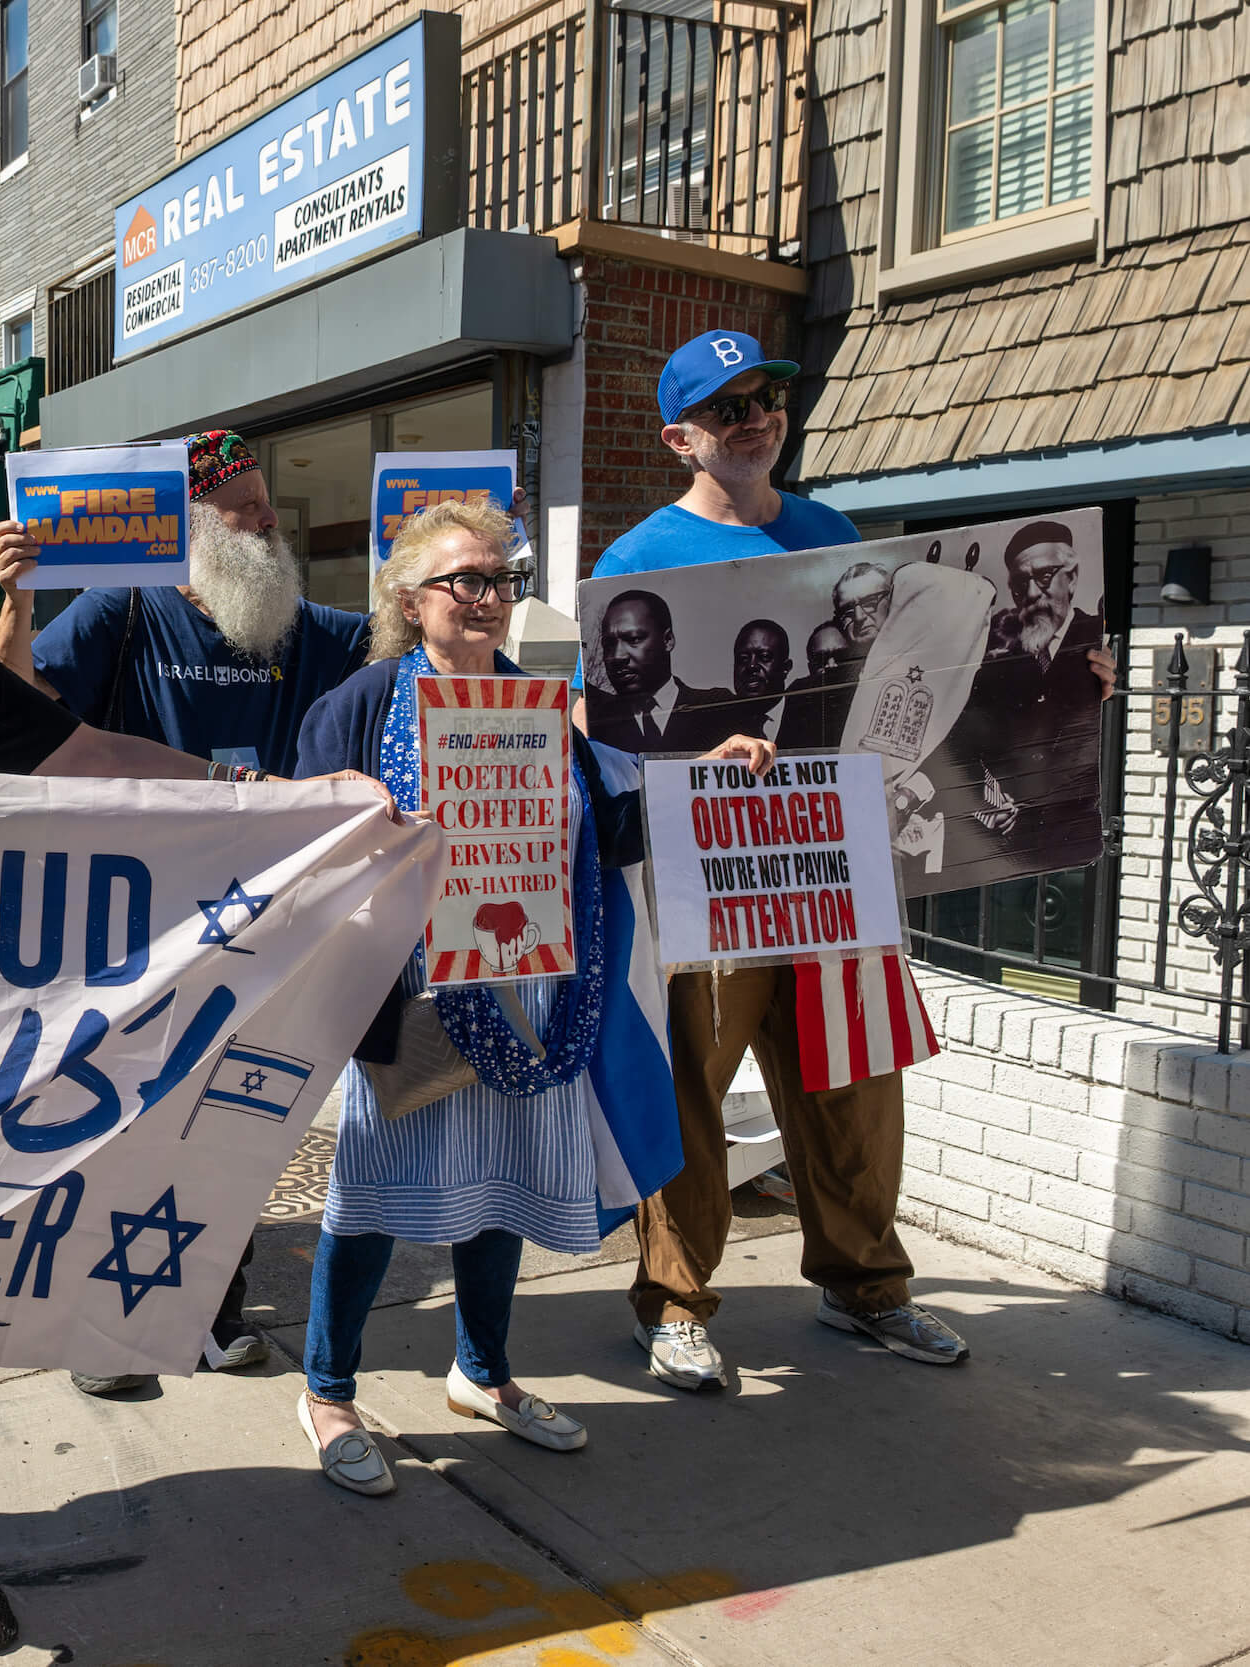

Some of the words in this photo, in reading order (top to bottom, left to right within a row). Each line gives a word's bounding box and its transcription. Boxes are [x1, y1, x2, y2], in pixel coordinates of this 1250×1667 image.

[163, 166, 245, 247] REAL
[259, 58, 410, 196] ESTATE
[294, 166, 384, 229] CONSULTANTS
[276, 214, 346, 265] APARTMENT
[349, 185, 405, 233] RENTALS
[124, 226, 157, 265] MCR
[190, 233, 268, 294] 387-8200
[126, 267, 181, 310] RESIDENTIAL
[125, 290, 181, 332] COMMERCIAL
[710, 338, 744, 368] B
[60, 487, 156, 516] FIRE
[26, 514, 179, 545] MAMDANI
[157, 661, 214, 682] ISRAEL
[1155, 698, 1204, 726] 55
[437, 733, 547, 750] #ENDJEWHATRED
[437, 764, 554, 791] POETICA
[689, 765, 709, 790] IF
[712, 763, 792, 790] YOURE
[795, 761, 839, 785] NOT
[436, 798, 555, 830] COFFEE
[691, 792, 845, 850] OUTRAGED
[450, 840, 522, 867] ERVES
[527, 841, 556, 863] UP
[701, 854, 758, 892] YOU'RE
[758, 853, 792, 888] NOT
[794, 850, 850, 886] PAYING
[709, 888, 858, 952] ATTENTION
